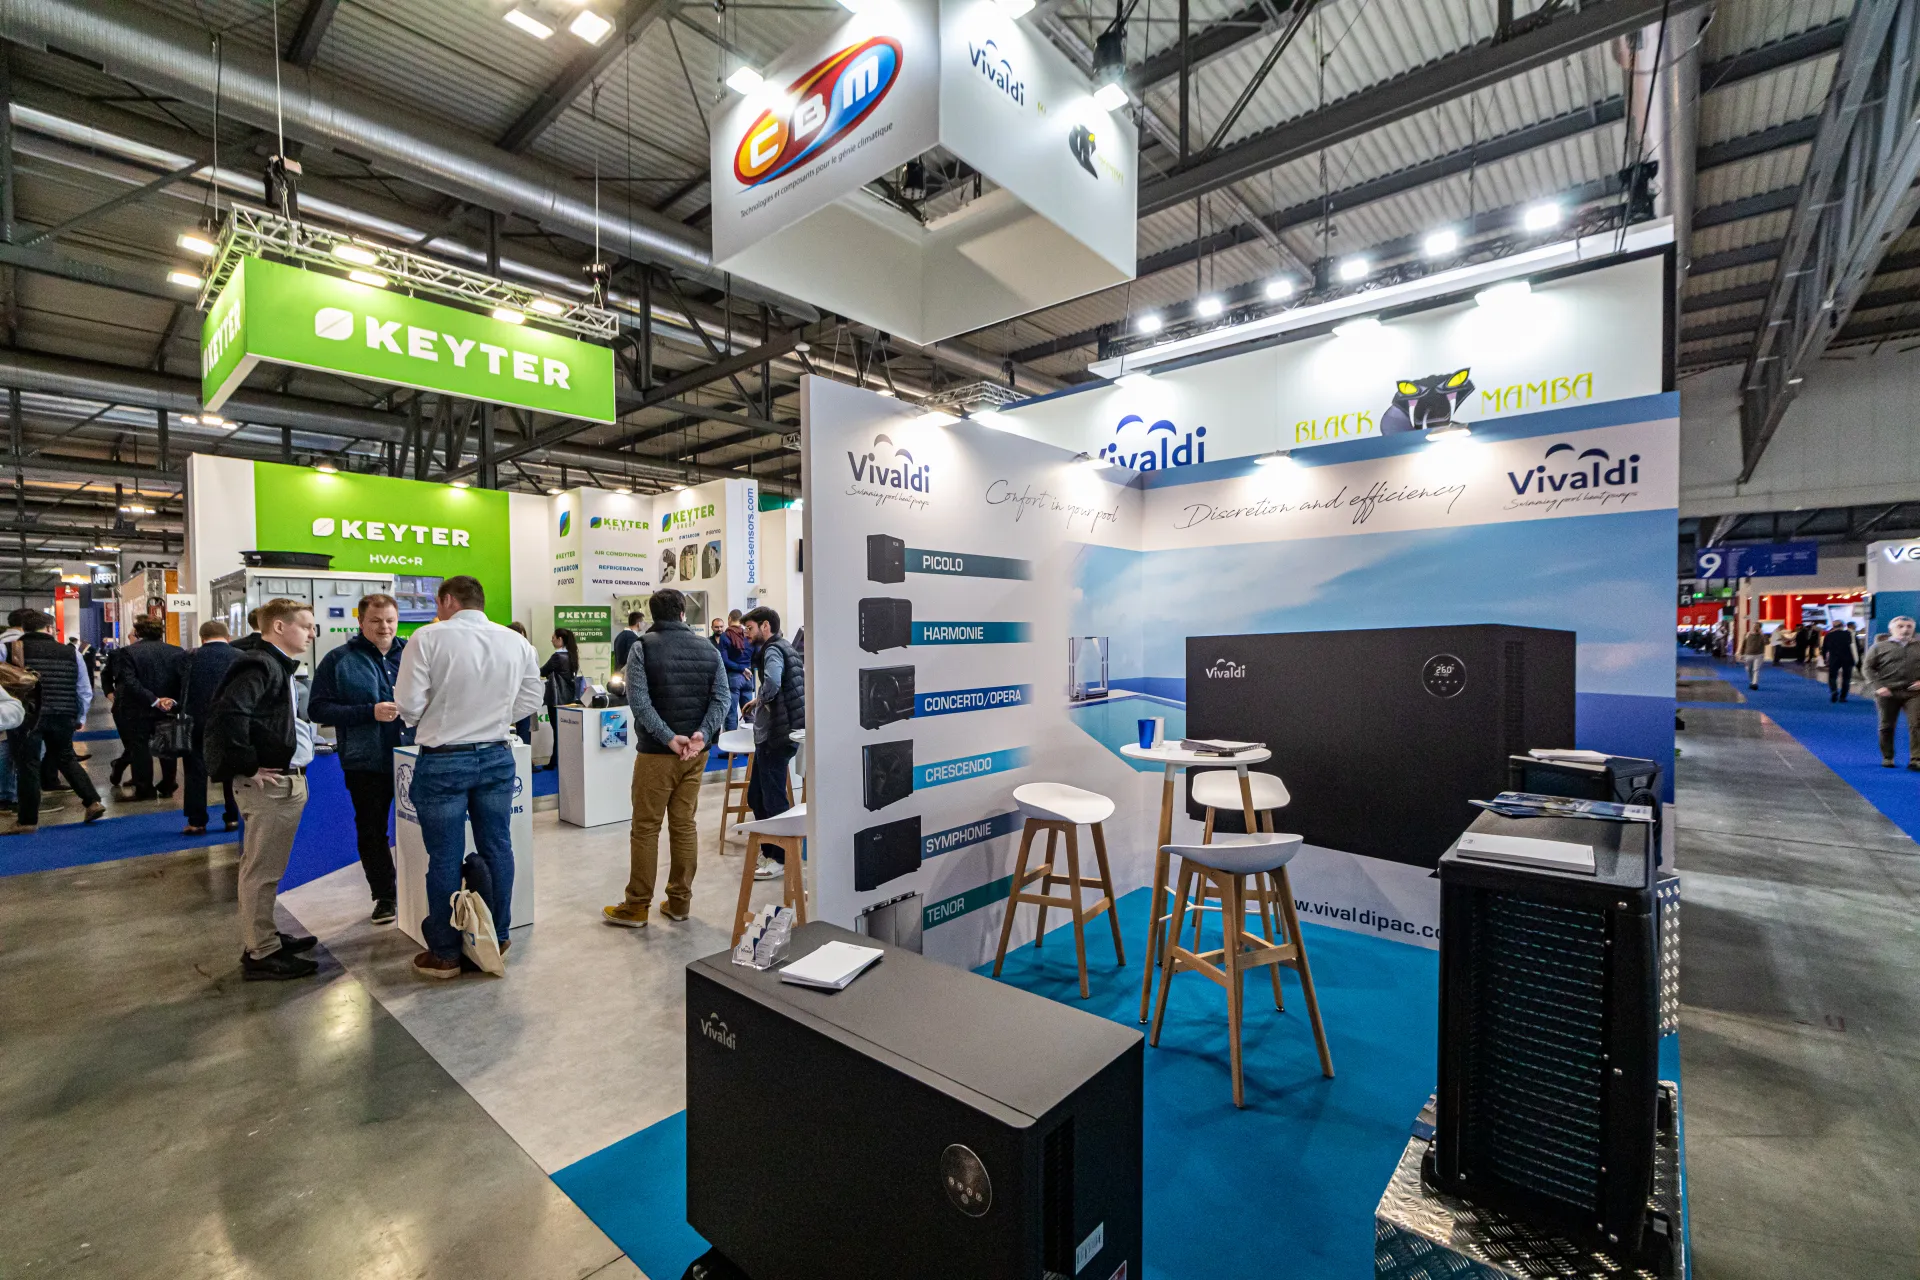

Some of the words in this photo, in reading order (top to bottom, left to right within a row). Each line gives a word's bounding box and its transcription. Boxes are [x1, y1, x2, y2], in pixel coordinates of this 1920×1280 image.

[969, 40, 1025, 106] Vivaldi
[740, 194, 774, 218] Technologies
[774, 189, 780, 199] et
[780, 169, 815, 196] composants
[815, 161, 830, 176] pour
[831, 155, 838, 164] le
[838, 143, 856, 162] génie
[857, 122, 893, 148] climatique
[207, 298, 241, 373] KEYTER
[365, 315, 571, 390] KEYTER
[1295, 410, 1373, 443] BLACK
[1481, 372, 1593, 415] MAMBA
[847, 451, 930, 493] Vivaldi
[1507, 454, 1640, 495] Vivaldi
[673, 504, 715, 524] KEYTER
[1051, 497, 1064, 511] in
[1067, 504, 1094, 529] your
[1090, 505, 1119, 533] pool
[1173, 497, 1296, 530] Discretion
[1299, 485, 1347, 511] and
[1349, 481, 1466, 525] efficiency
[341, 519, 470, 547] KEYTER
[603, 517, 649, 530] KEYTER
[369, 554, 423, 566] HVAC+R
[558, 551, 575, 559] KEYTER
[605, 551, 647, 559] CONDITIONING
[922, 555, 964, 572] PICOLO
[1699, 553, 1721, 578] 9
[598, 564, 644, 572] REFRIGERATION
[566, 611, 607, 619] KEYTER
[923, 627, 984, 641] HARMONIE
[1206, 664, 1246, 679] Vivaldi
[924, 689, 1022, 712] CONCERTO/OPERA
[925, 757, 992, 782] CRESCENDO
[926, 822, 992, 853] SYMPHONIE
[927, 897, 965, 923] TENOR
[701, 1018, 736, 1050] Vivaldi
